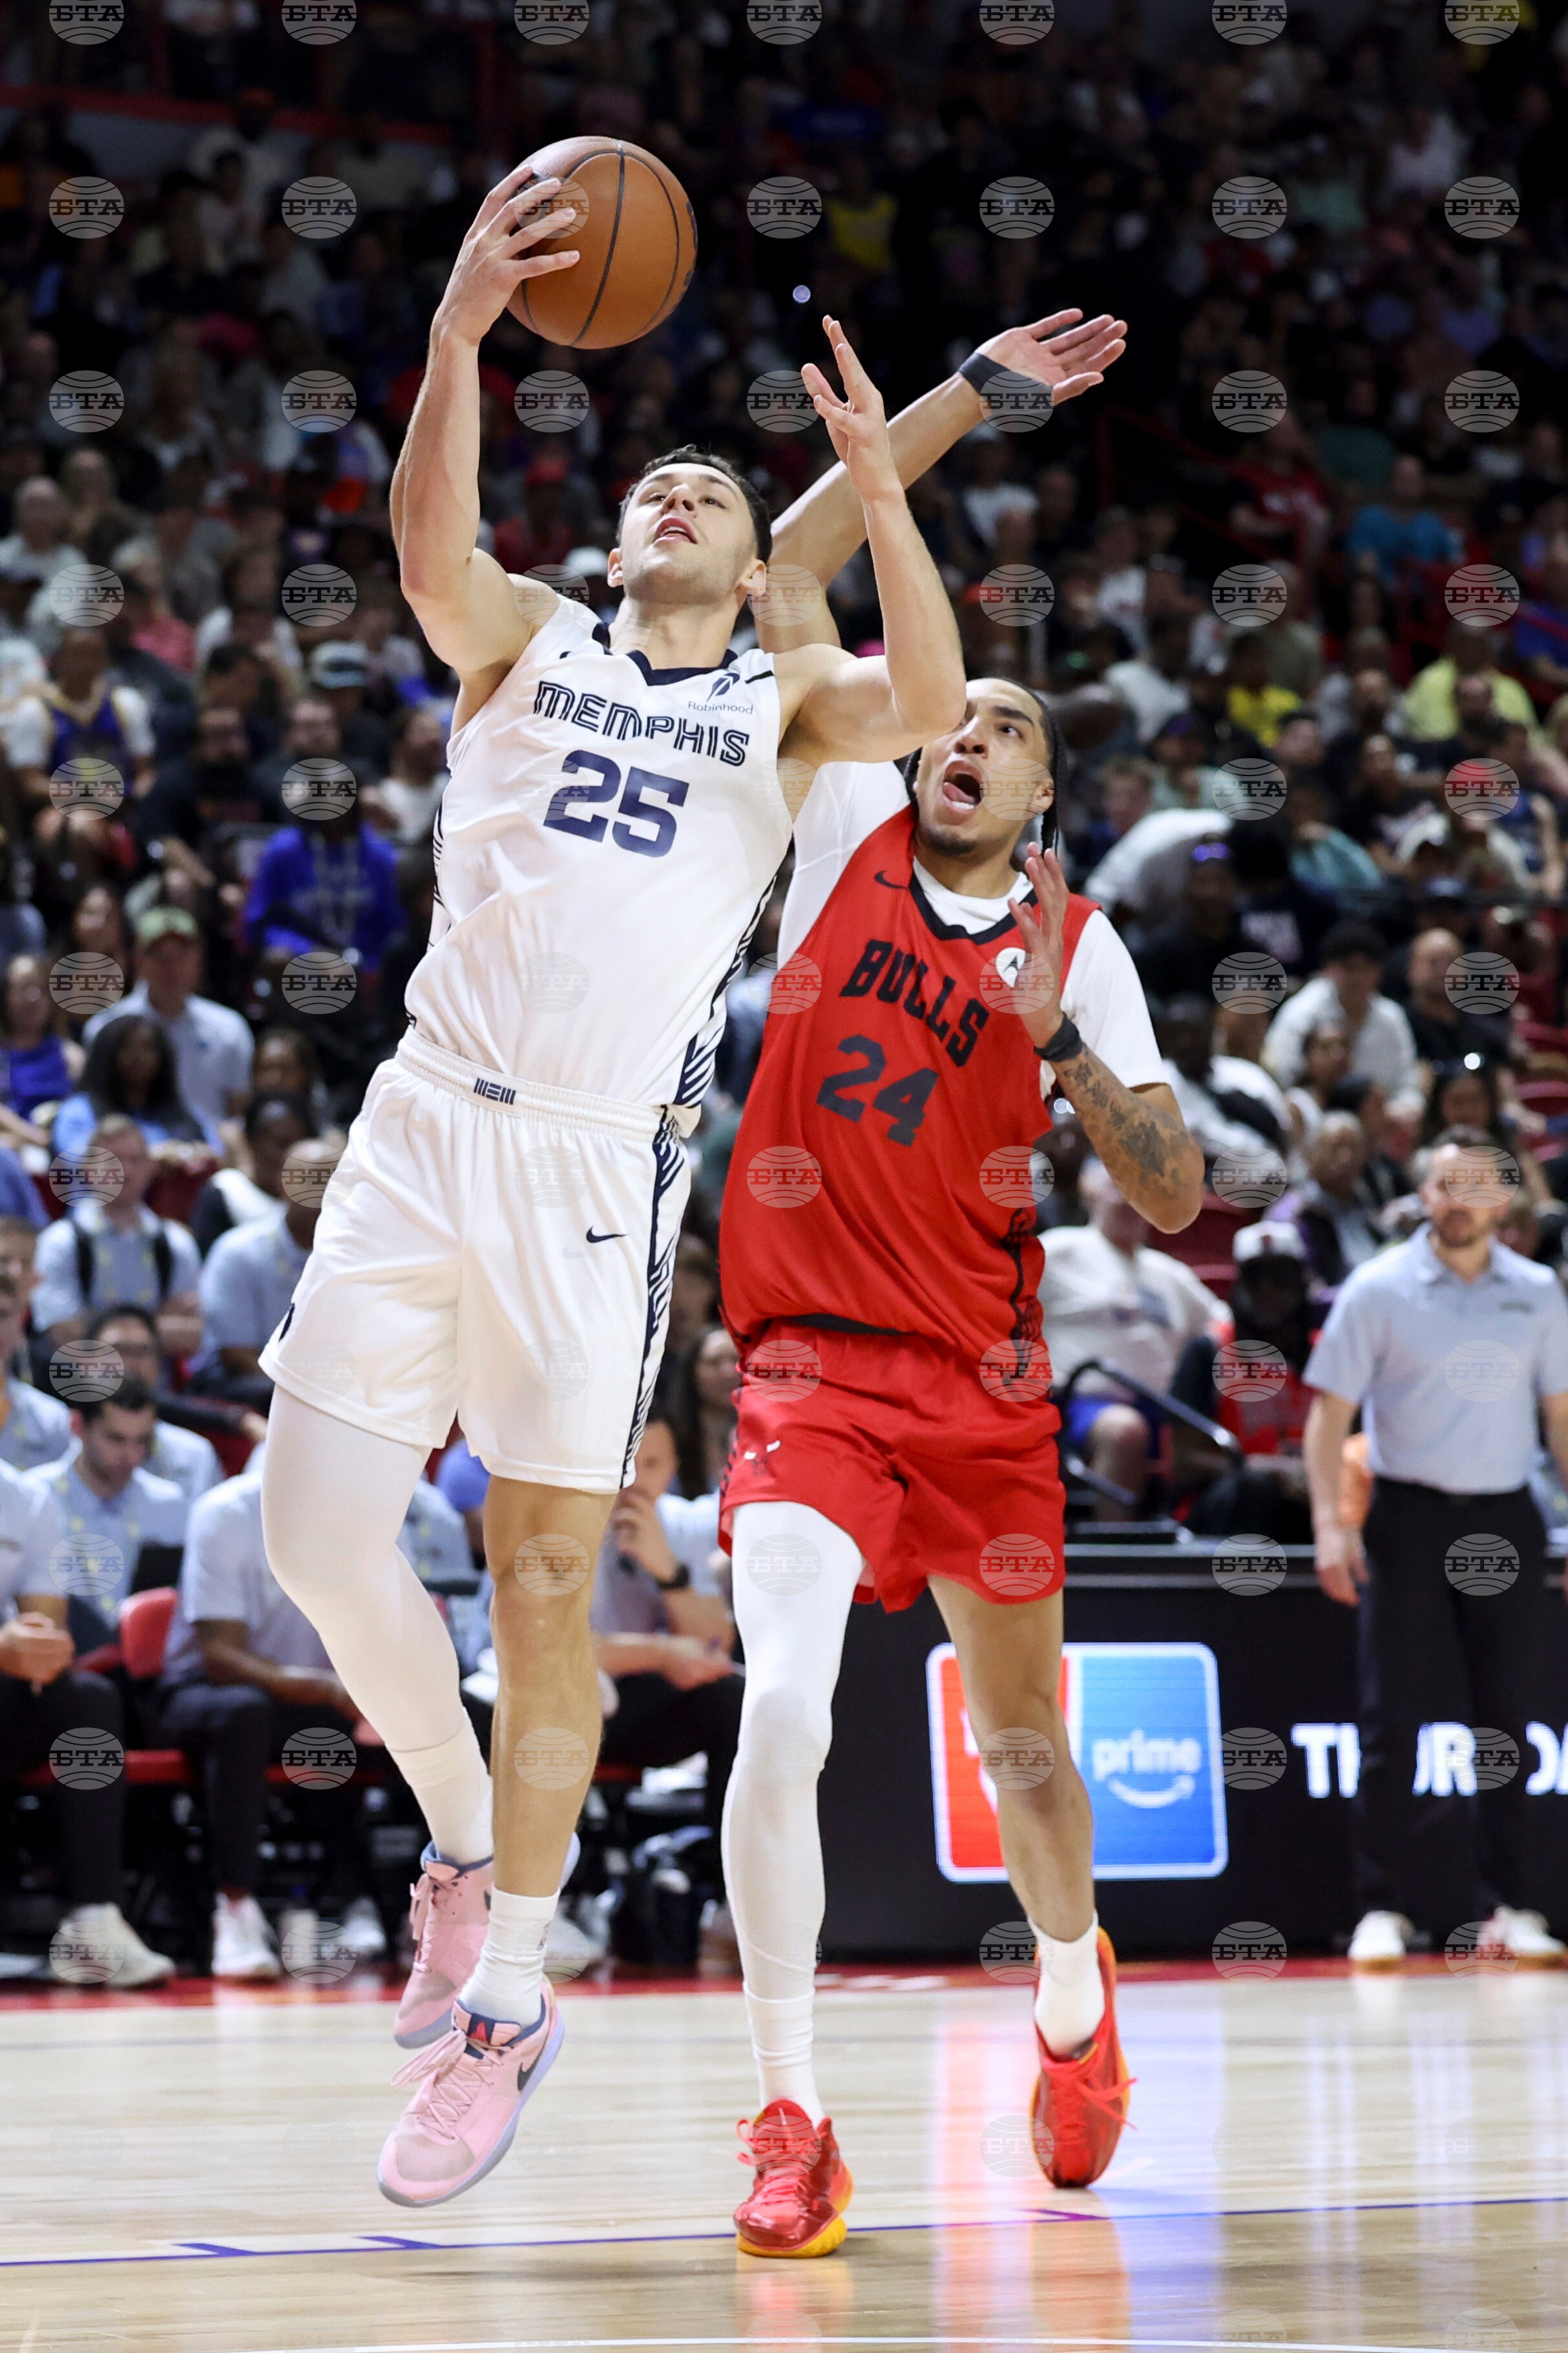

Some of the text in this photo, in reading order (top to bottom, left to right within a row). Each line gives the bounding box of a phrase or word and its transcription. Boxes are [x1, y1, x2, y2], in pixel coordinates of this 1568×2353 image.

[533, 681, 750, 767] MEMPHIS
[688, 701, 753, 715] Robinhood
[543, 750, 689, 858] 25
[839, 939, 989, 1067] BULLS
[816, 1034, 939, 1148] 24
